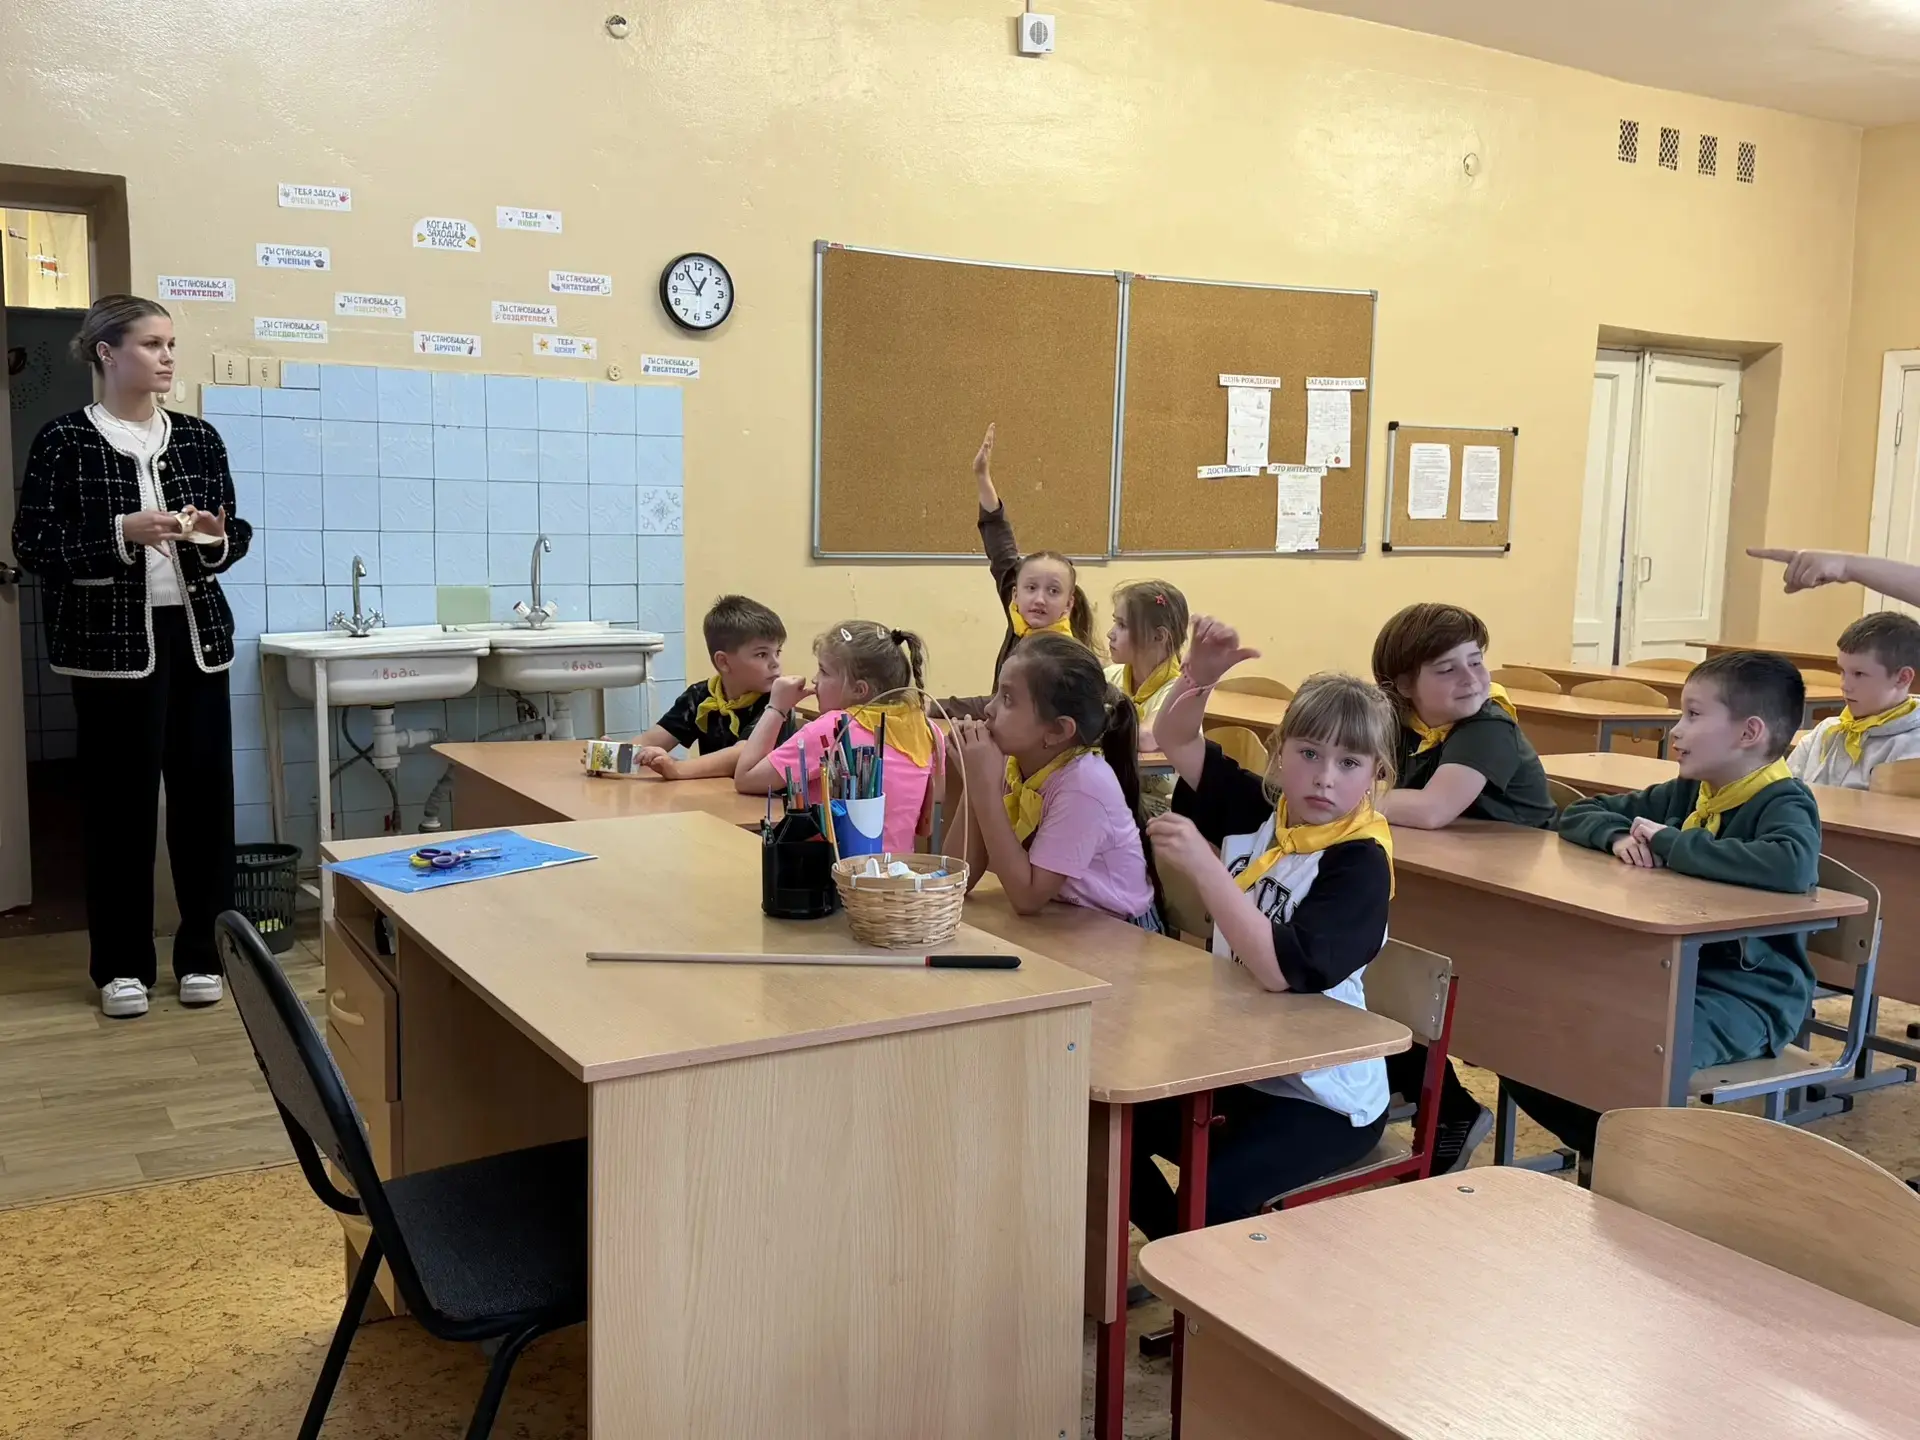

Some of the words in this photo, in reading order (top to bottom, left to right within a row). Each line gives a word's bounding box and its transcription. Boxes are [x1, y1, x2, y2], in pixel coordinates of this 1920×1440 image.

[294, 187, 312, 196] ТЕБЯ
[313, 188, 336, 198] ЗДЕСЬ
[521, 210, 538, 219] ТЕБЯ
[426, 219, 453, 230] КОГДА
[454, 222, 466, 231] ТЫ
[427, 229, 467, 240] ЗАХОДИШЬ
[431, 237, 437, 246] В
[438, 238, 462, 248] КЛАСС
[264, 246, 275, 255] ТЫ
[275, 247, 322, 258] СТАНОВИШЬСЯ
[694, 261, 704, 271] 12
[675, 272, 685, 281] 10
[708, 267, 713, 276] 1
[556, 273, 565, 281] ТЫ
[714, 276, 722, 286] 2
[166, 278, 177, 287] ТЫ
[178, 279, 226, 289] СТАНОВИШЬСЯ
[170, 288, 224, 298] МЕЧТАТЕЛЕМ
[671, 284, 678, 294] 9
[343, 295, 353, 303] ТЫ
[717, 290, 724, 299] 3
[674, 297, 681, 306] 8
[713, 302, 720, 311] 4
[499, 304, 508, 312] ТЫ
[682, 307, 689, 317] 7
[693, 313, 700, 321] 6
[705, 310, 712, 320] 5
[262, 320, 273, 329] ТЫ
[273, 321, 320, 331] СТАНОВИШЬСЯ
[420, 334, 431, 342] ТЫ
[434, 343, 462, 353] ДРУГОМ
[647, 357, 656, 365] ТЫ
[651, 365, 689, 374] ПИСАТЕЛЕМ
